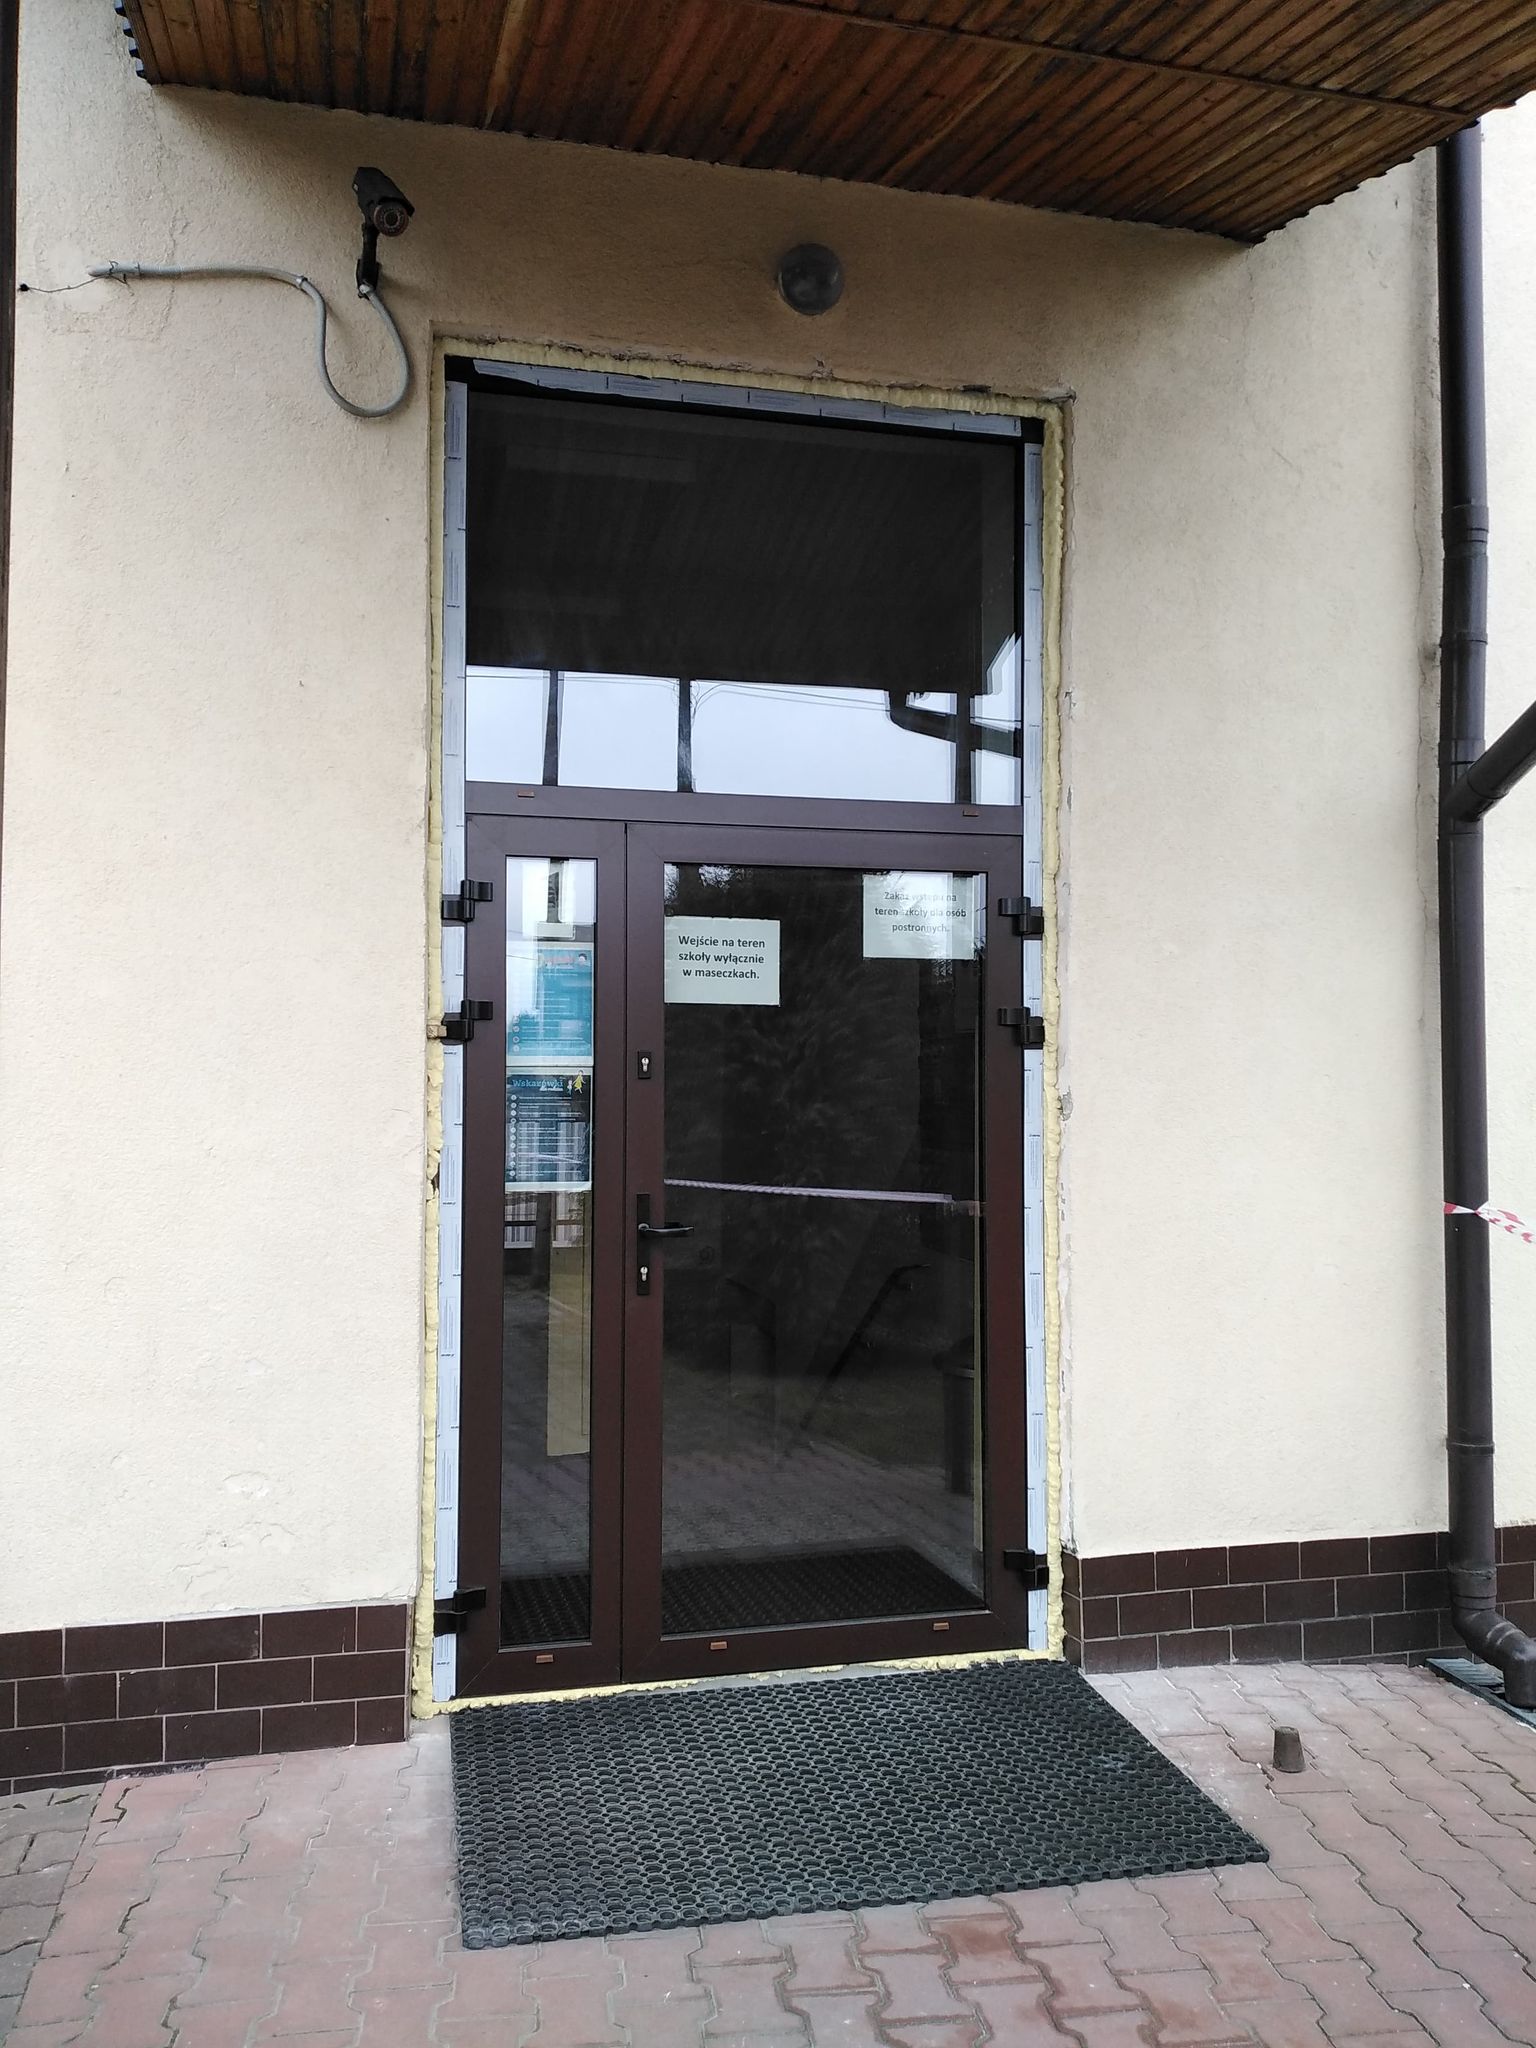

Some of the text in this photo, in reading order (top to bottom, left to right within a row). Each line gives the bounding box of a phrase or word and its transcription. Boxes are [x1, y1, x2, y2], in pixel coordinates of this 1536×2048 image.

[946, 894, 957, 902] na
[874, 907, 899, 916] teren
[900, 907, 928, 918] zkoły
[945, 908, 967, 917] osób
[892, 923, 951, 934] postronnych.
[678, 935, 766, 948] Wejście na teren
[678, 951, 765, 965] szkoły wyłącznie
[682, 968, 760, 979] w maseczkach.
[512, 1078, 563, 1087] Wskazówki
